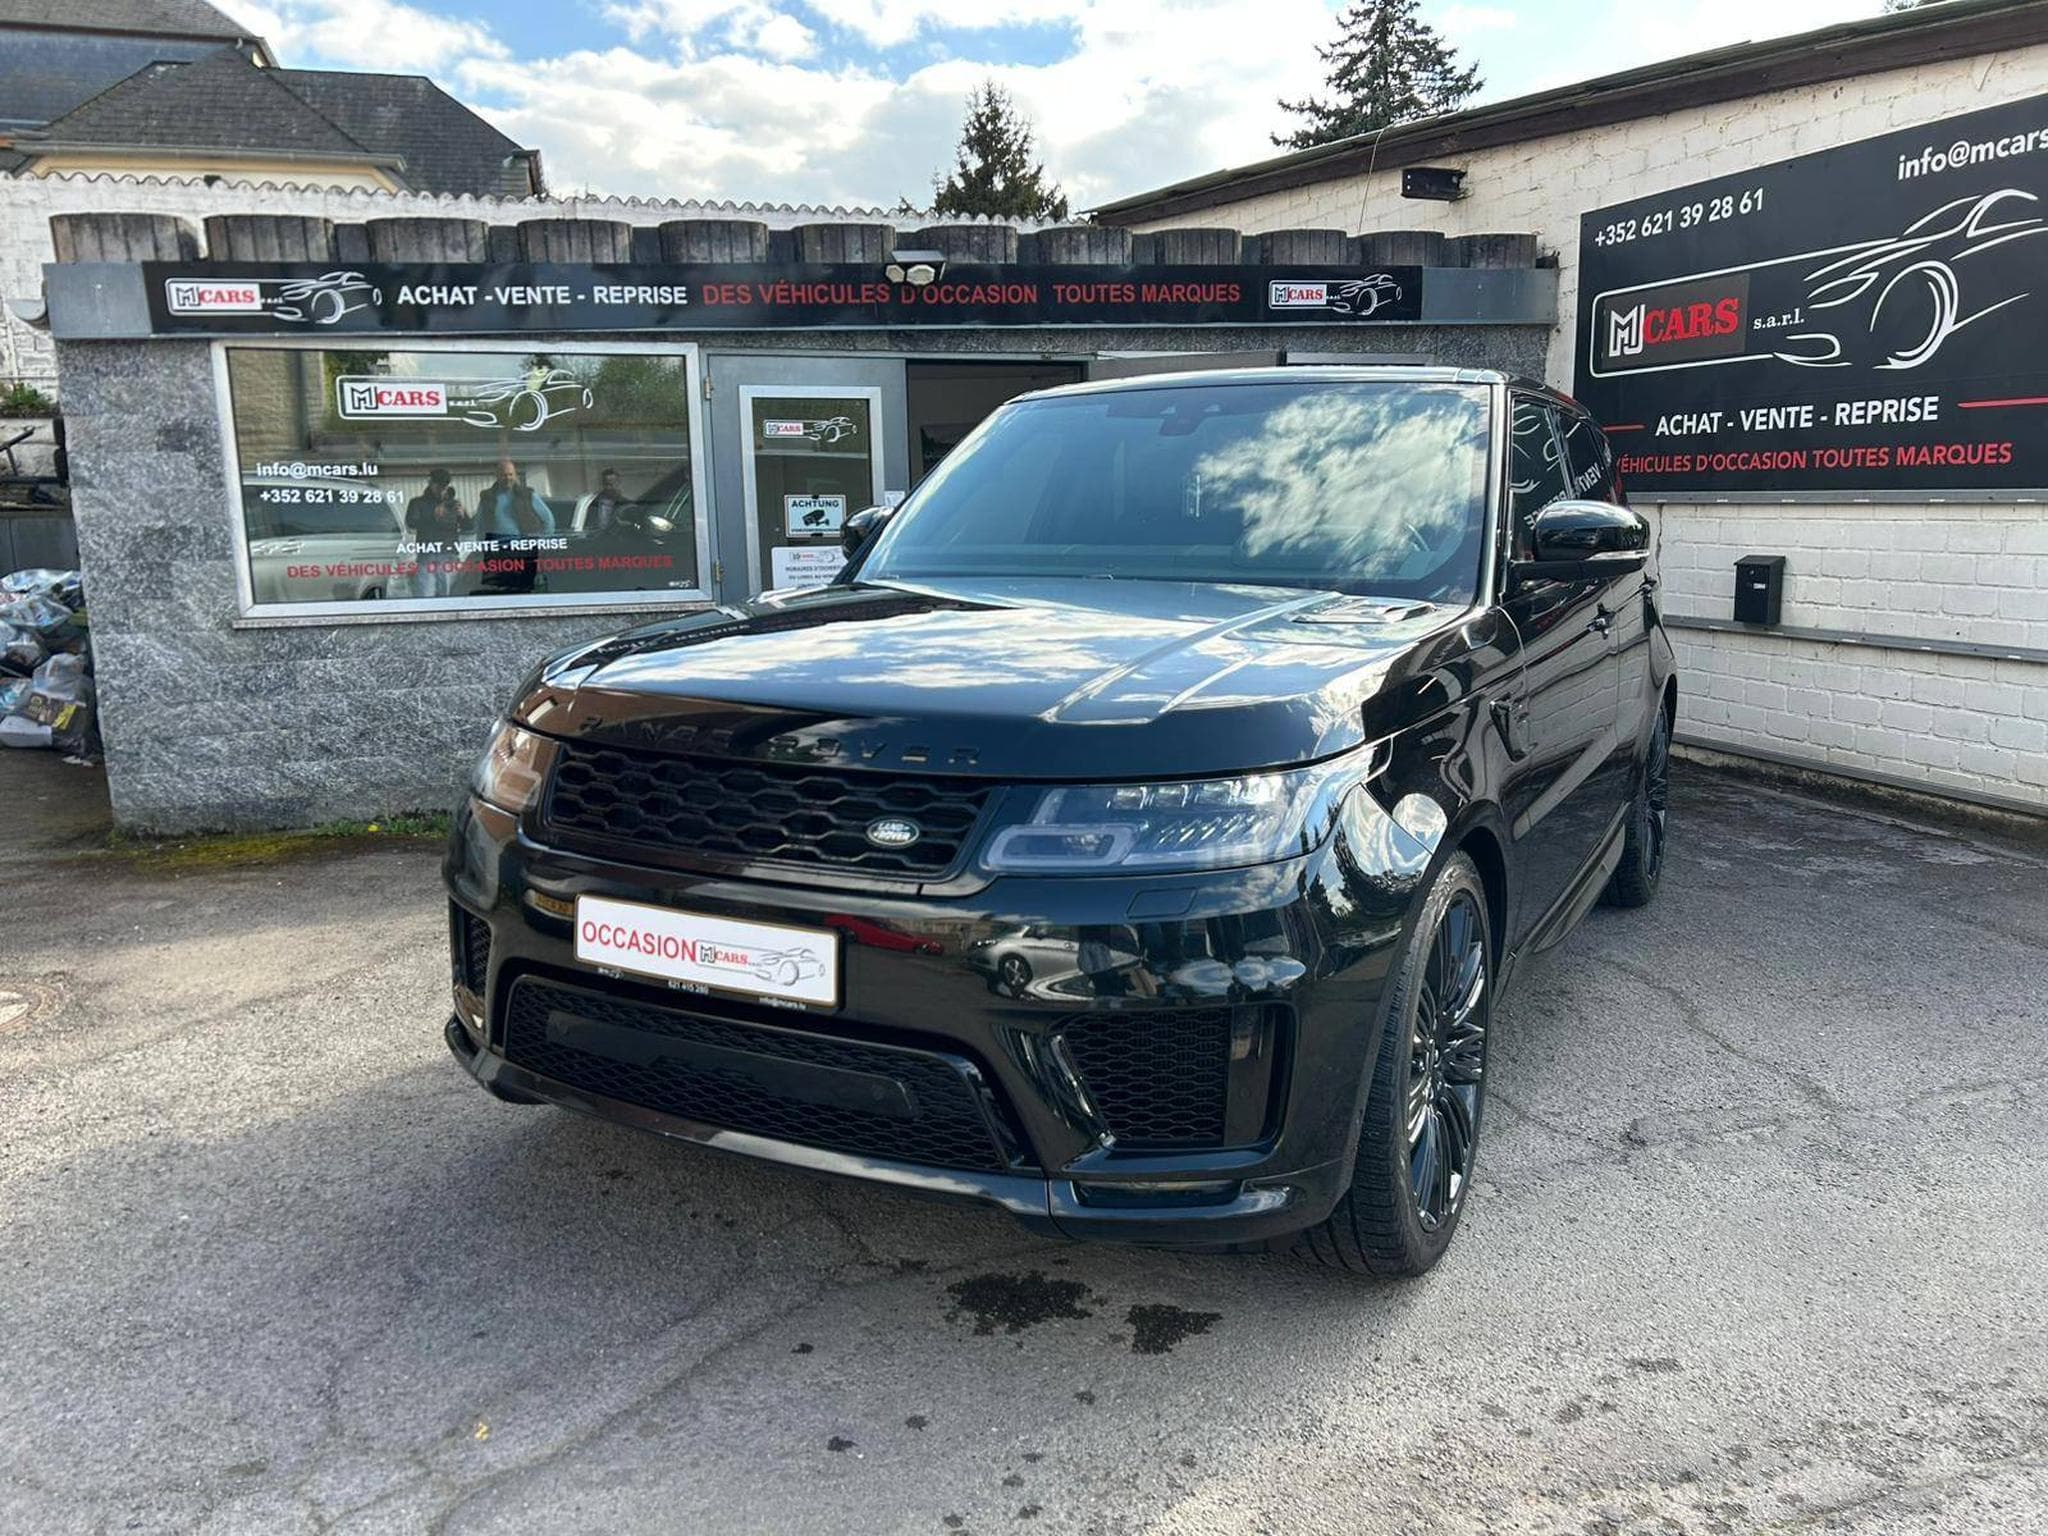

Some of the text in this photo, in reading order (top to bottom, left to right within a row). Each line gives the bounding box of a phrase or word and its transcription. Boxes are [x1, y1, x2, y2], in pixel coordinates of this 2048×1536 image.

[1594, 188, 1764, 247] +352 621 39 28 61
[397, 286, 477, 305] ACHAT
[593, 286, 688, 304] REPRISE
[702, 284, 751, 305] DES
[758, 279, 890, 305] VÉHICULES
[900, 284, 1038, 304] D'OCCASION
[1052, 284, 1136, 304] TOUTES
[1141, 284, 1241, 304] MARQUES
[1753, 308, 1805, 330] s.a.r.l.
[1655, 412, 1722, 436] ACHAT
[1740, 405, 1814, 431] VENTE
[1834, 396, 1940, 426] REPRISE
[1617, 442, 2013, 473] ÉHICULES D'OCCASION TOUTES MARQUES
[256, 462, 378, 479] info@mcars.lu
[260, 489, 404, 504] +352 621 39 28 61
[791, 500, 839, 508] ACHTUNG
[396, 541, 443, 554] ACHAT
[454, 540, 499, 553] VENTE
[510, 537, 568, 551] REPRISE
[287, 564, 320, 578] DES
[325, 561, 419, 577] VÉHICULES
[535, 556, 594, 572] TOUTES
[599, 554, 673, 570] MARQUES
[582, 921, 697, 963] OCCASION
